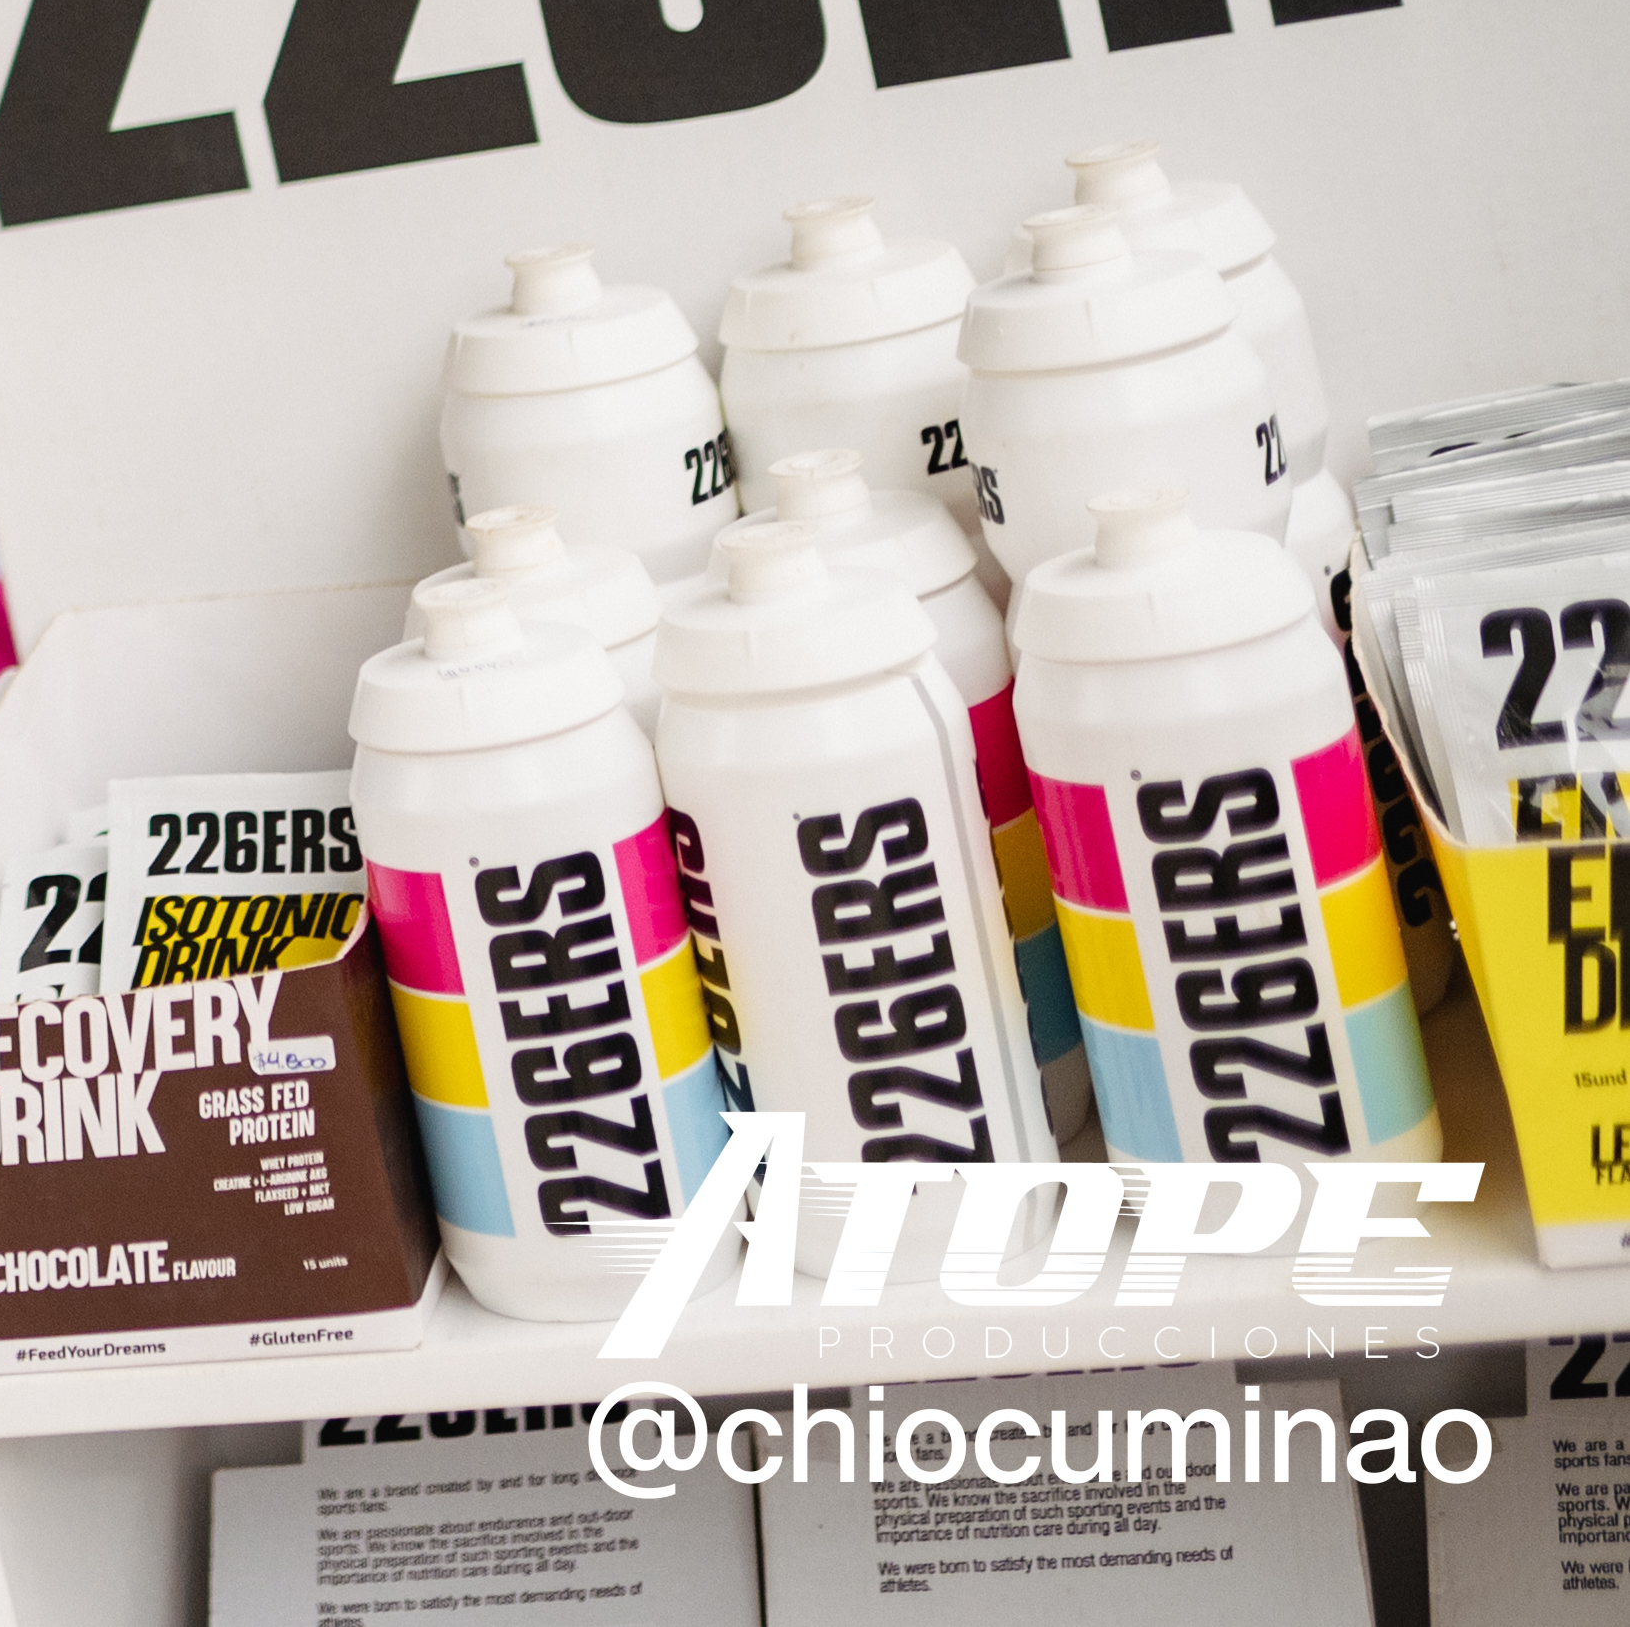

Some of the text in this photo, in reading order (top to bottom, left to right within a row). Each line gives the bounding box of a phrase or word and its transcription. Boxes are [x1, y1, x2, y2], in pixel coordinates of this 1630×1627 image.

[147, 807, 364, 877] 226ERS
[132, 892, 364, 947] ISOTONIC
[131, 935, 296, 991] DRINK
[1135, 766, 1351, 1163] 226ERS
[474, 849, 671, 1237] 226ERS
[199, 1079, 309, 1120] GRASS FED
[229, 1108, 315, 1146] PROTEIN
[260, 1150, 324, 1171] WHEY PROTEIN
[213, 1175, 252, 1192] CREATINE
[255, 1186, 299, 1204] FLAXSEED
[309, 1182, 330, 1196] MCT
[284, 1197, 334, 1216] LOW SUGAR
[172, 1257, 236, 1282] FLAVOUR
[303, 1255, 348, 1271] 15 units
[248, 1327, 354, 1347] #GlutenFree
[15, 1340, 166, 1363] #FeedYourDreams
[1553, 1439, 1625, 1453] We are a
[1554, 1454, 1600, 1470] sports
[874, 1480, 1187, 1511] sports. We know the sacrifice involved in the
[1556, 1483, 1609, 1497] We are
[875, 1495, 1226, 1529] physical preparation of such sporting events and the
[1557, 1497, 1610, 1515] sports.
[876, 1517, 1162, 1545] importance of nutrition care during all day.
[1558, 1512, 1619, 1531] physical
[878, 1545, 1234, 1576] We were born to satisfy the most demanding needs of
[1561, 1560, 1624, 1575] We were
[1562, 1575, 1620, 1591] athletes.
